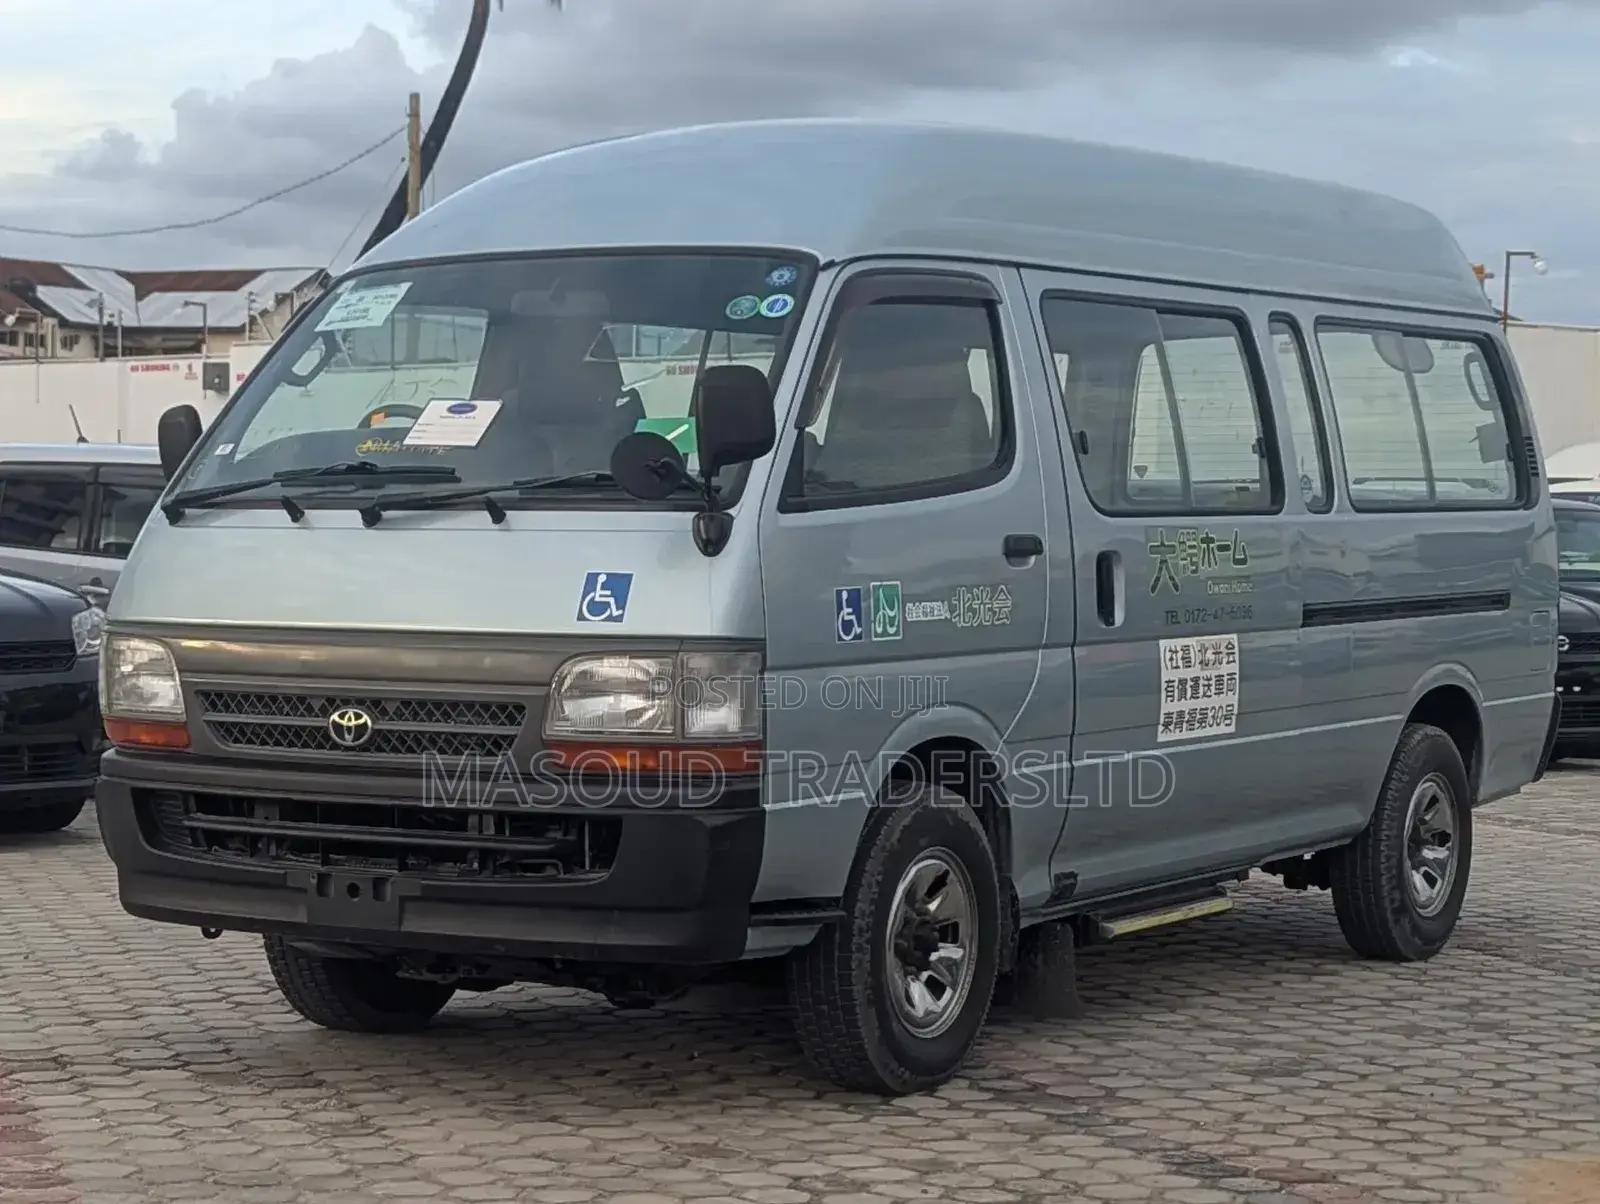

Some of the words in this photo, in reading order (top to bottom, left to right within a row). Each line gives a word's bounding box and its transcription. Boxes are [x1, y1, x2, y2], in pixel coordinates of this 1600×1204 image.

[952, 584, 1012, 627] 北光会
[1164, 610, 1181, 625] TEL
